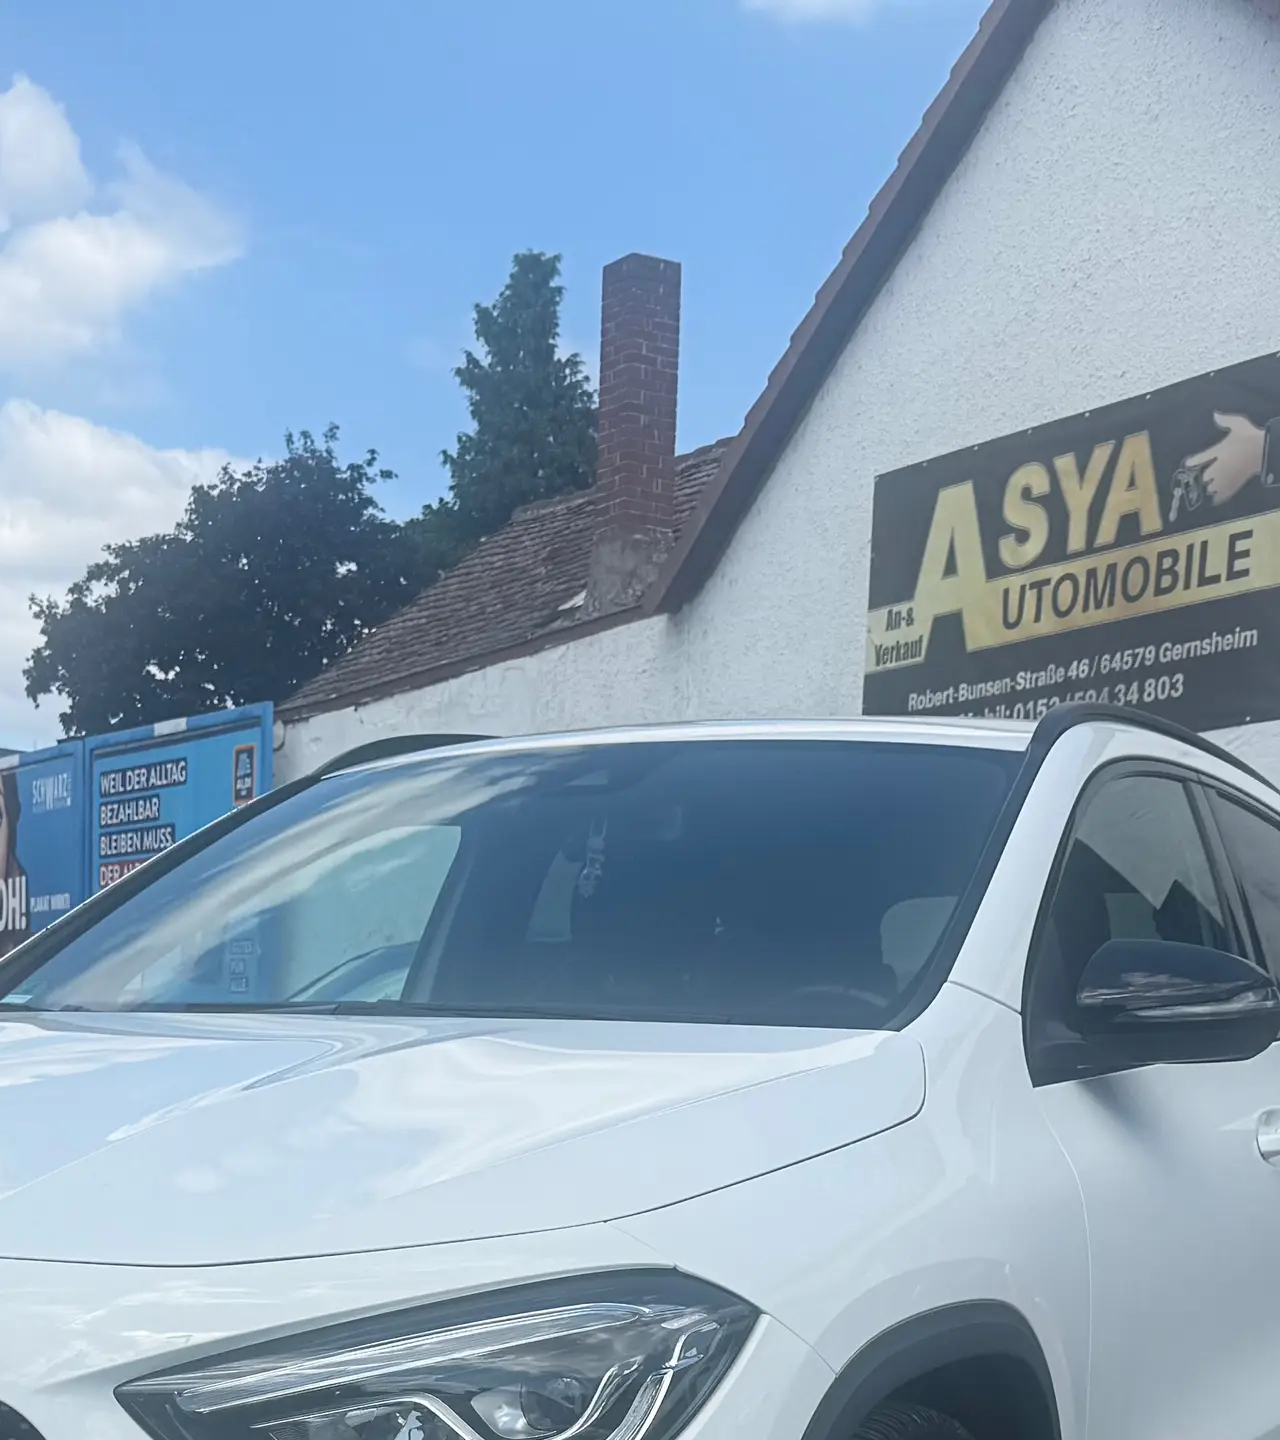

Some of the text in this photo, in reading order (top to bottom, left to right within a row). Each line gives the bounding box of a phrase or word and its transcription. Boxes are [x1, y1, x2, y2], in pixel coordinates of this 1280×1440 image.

[874, 634, 924, 667] Verkauf
[908, 664, 1065, 712] Robert-Bunsen-Straße
[1068, 658, 1089, 680] 46
[1100, 645, 1156, 674] 64579
[1159, 627, 1258, 663] Gernsheim
[1114, 681, 1139, 706] 34
[1143, 673, 1184, 703] 803
[101, 761, 186, 795] WEIL DER ALLTAG
[101, 798, 159, 826] BEZAHLBAR
[100, 832, 141, 856] BLEIBEN
[100, 863, 121, 888] DER
